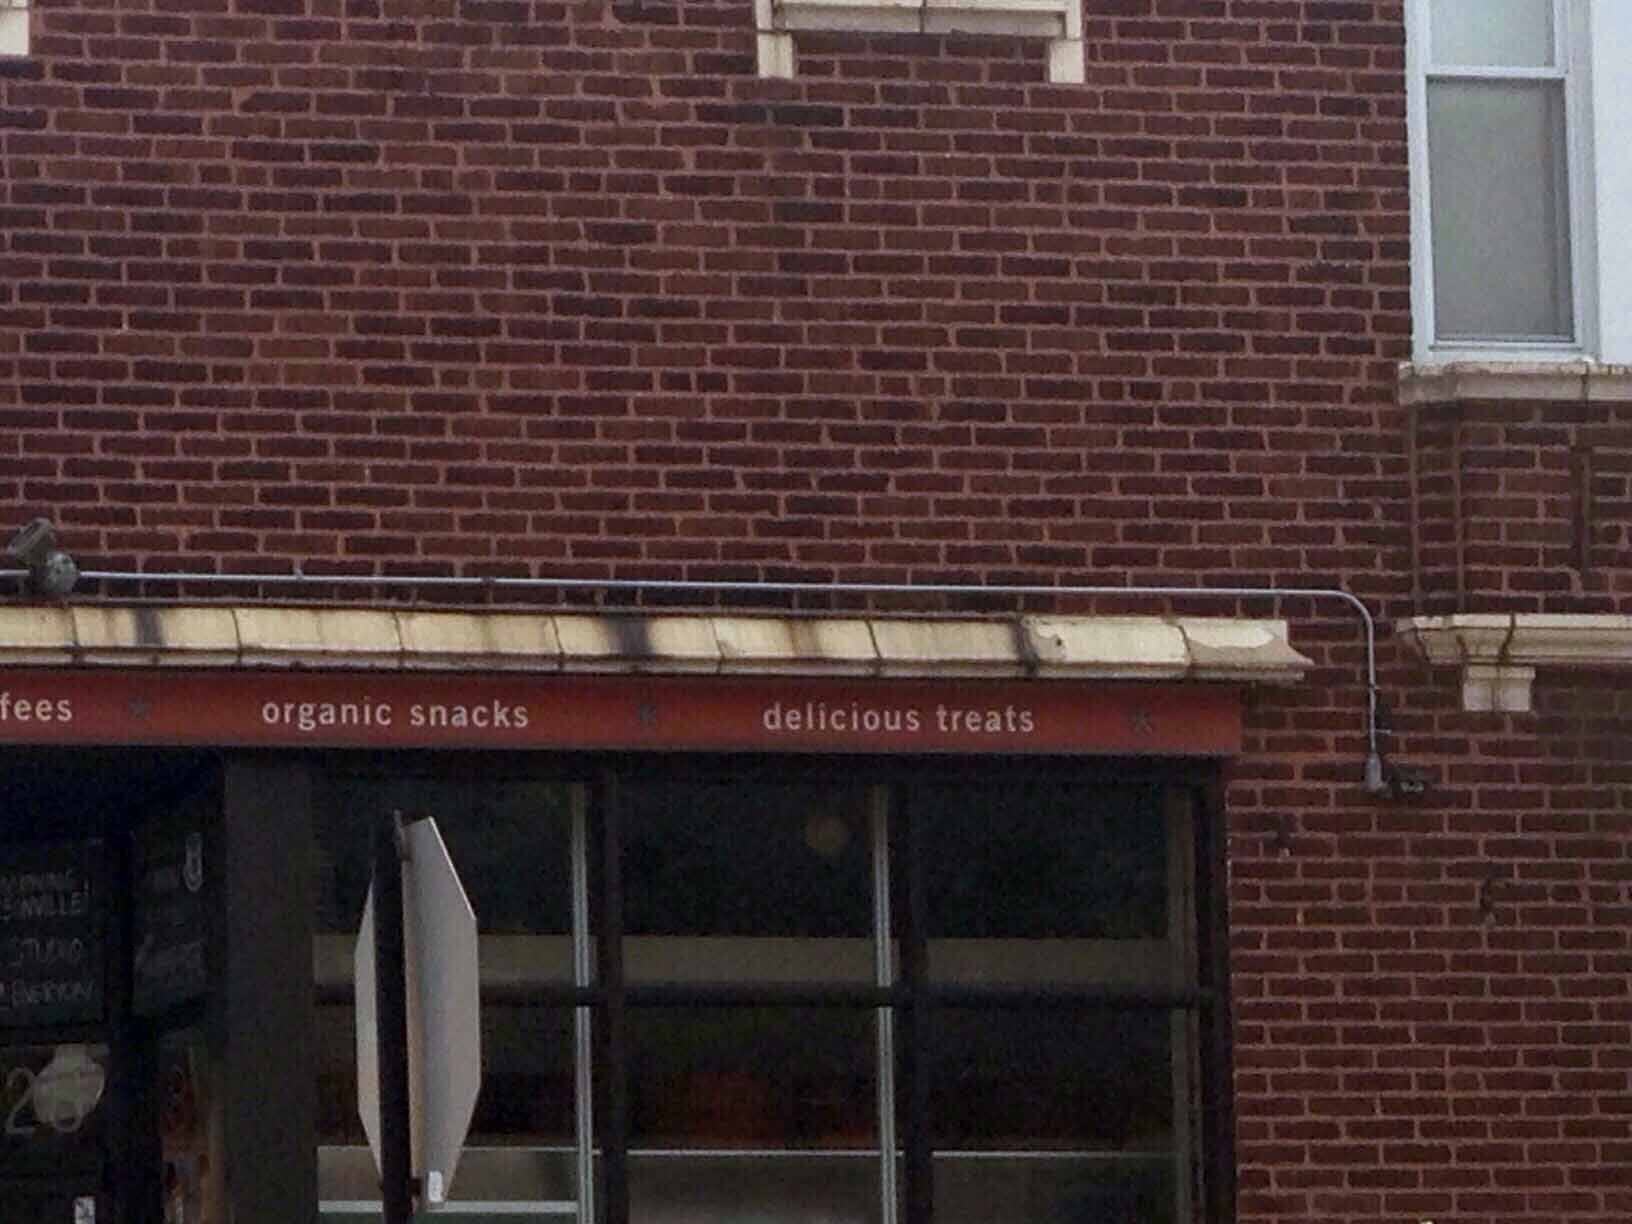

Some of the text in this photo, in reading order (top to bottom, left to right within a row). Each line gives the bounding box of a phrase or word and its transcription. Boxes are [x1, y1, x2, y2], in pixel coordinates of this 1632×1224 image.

[262, 696, 530, 732] organic snacks
[763, 702, 1036, 733] delicious treats
